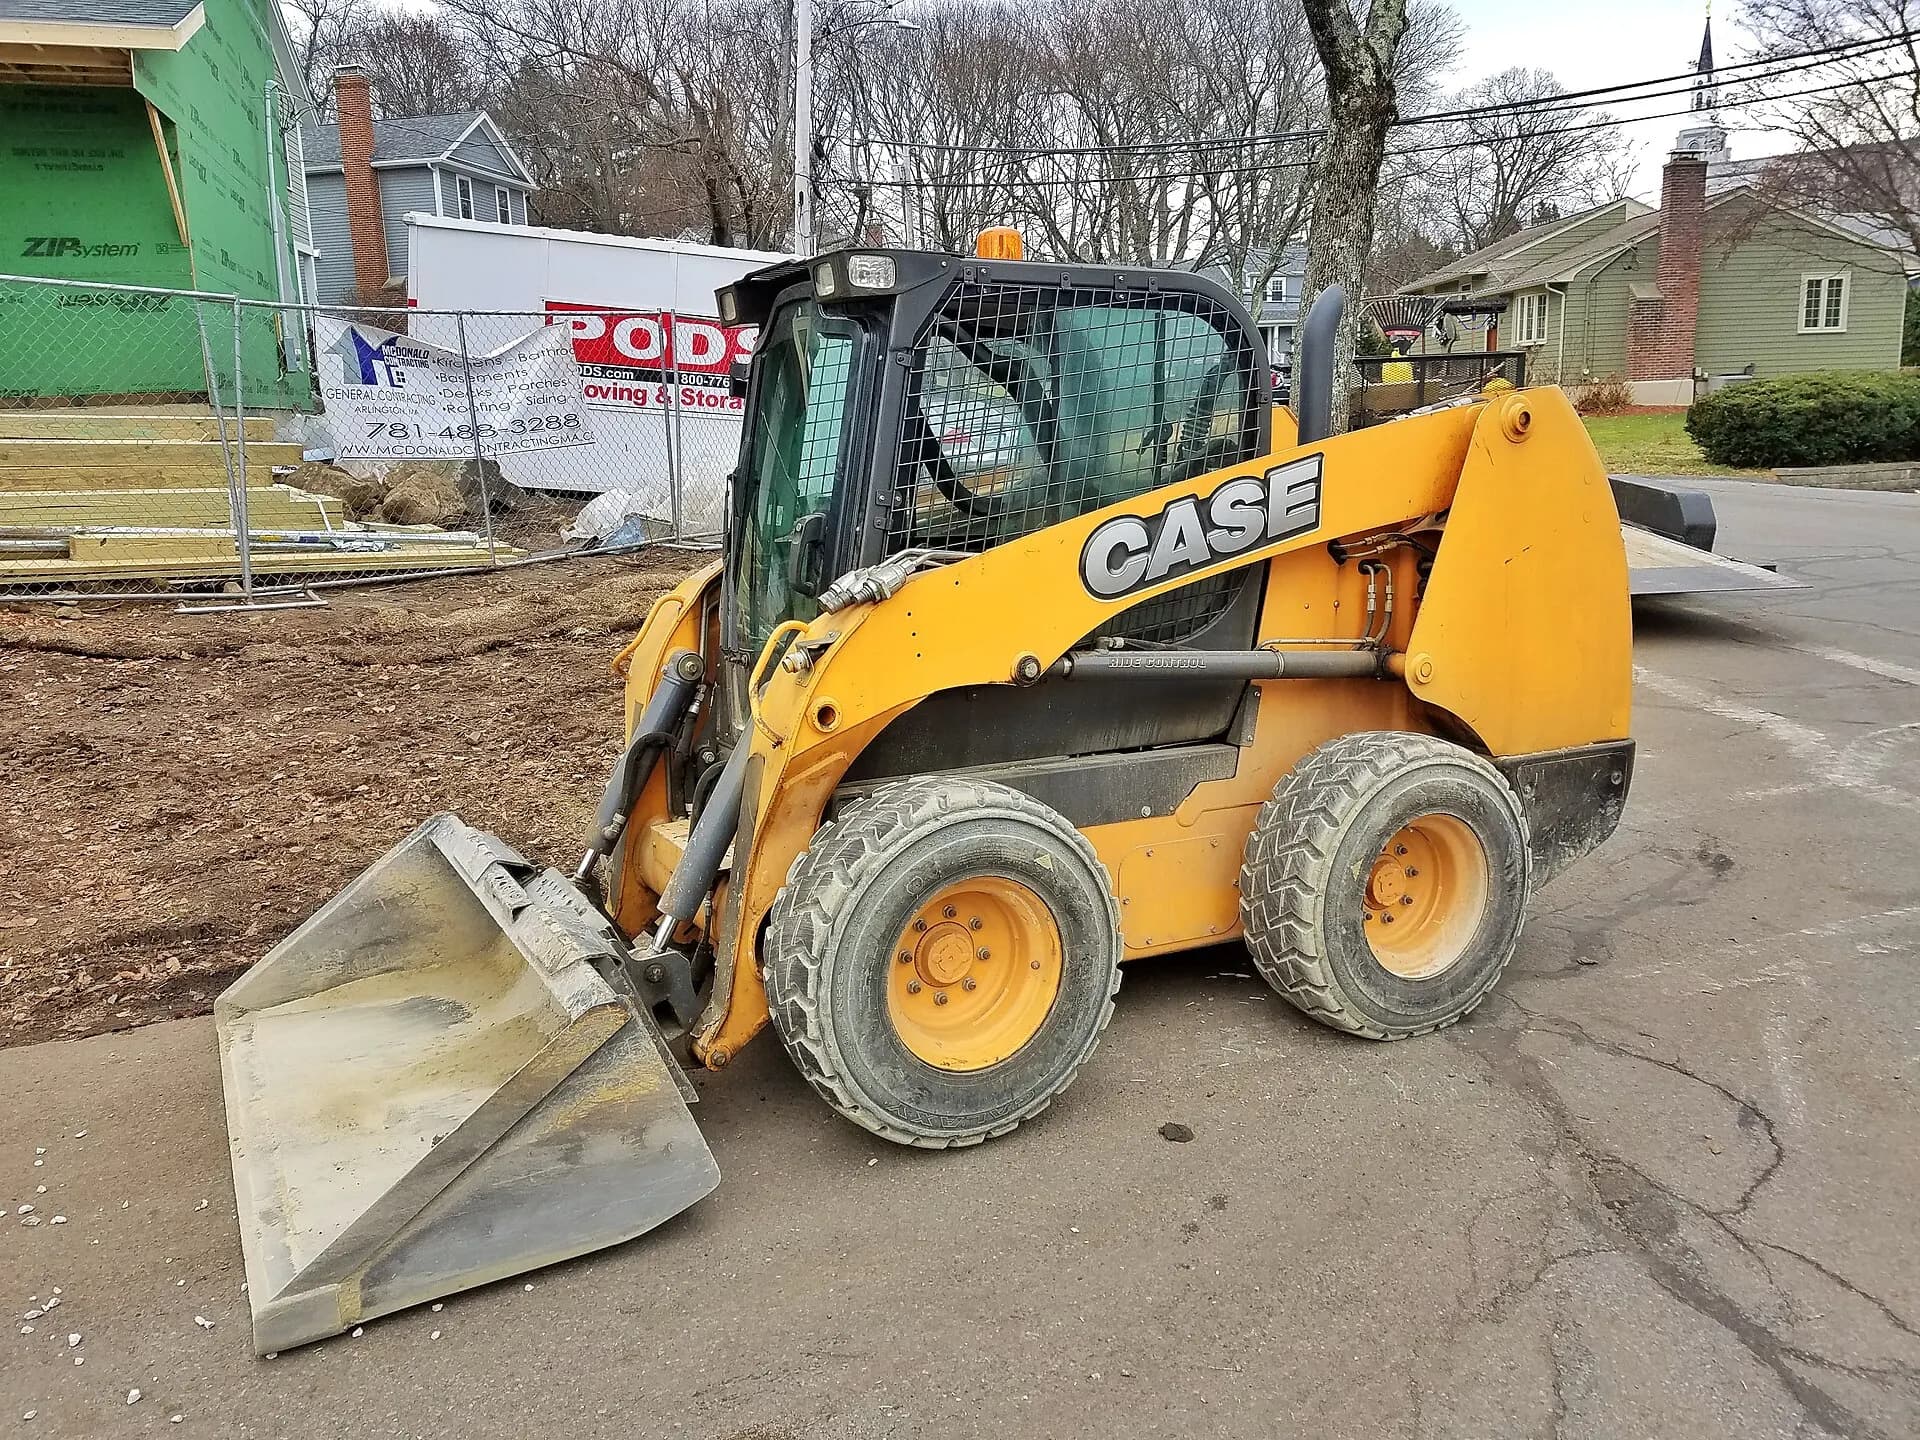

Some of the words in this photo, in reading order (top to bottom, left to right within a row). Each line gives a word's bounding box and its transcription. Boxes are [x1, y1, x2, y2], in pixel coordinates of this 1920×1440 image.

[384, 356, 430, 369] CONTRACTING
[440, 368, 528, 383] Basements
[326, 388, 376, 401] GENERAL
[377, 390, 436, 405] CONTRACTING
[443, 387, 492, 399] Decks
[508, 378, 568, 393] Porches
[655, 386, 673, 405] &
[447, 401, 511, 414] Roofing
[526, 393, 567, 405] Siding
[365, 413, 582, 440] 781-488-3288
[1083, 457, 1321, 596] CASE
[1109, 657, 1141, 668] RIDE
[1145, 657, 1206, 669] CONTROL
